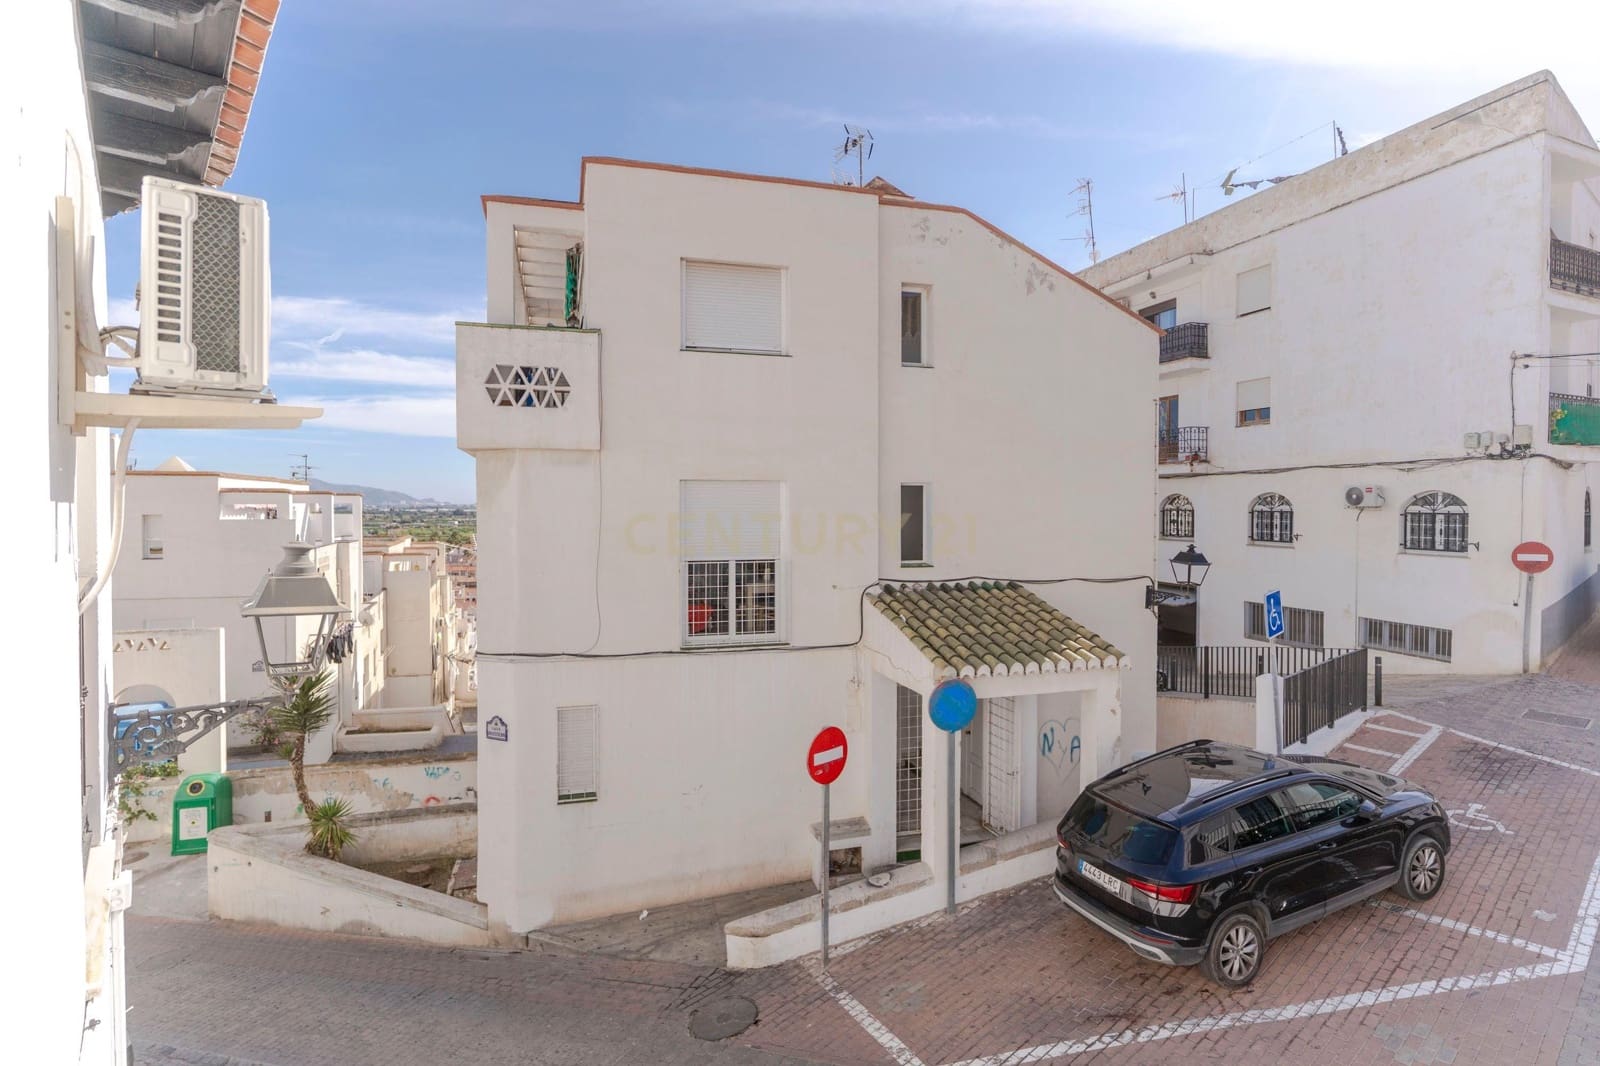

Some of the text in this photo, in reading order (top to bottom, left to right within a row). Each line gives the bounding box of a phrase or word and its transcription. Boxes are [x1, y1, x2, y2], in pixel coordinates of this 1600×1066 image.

[1042, 726, 1055, 756] N
[1070, 735, 1081, 764] A
[1083, 863, 1119, 890] 4443 LRC
